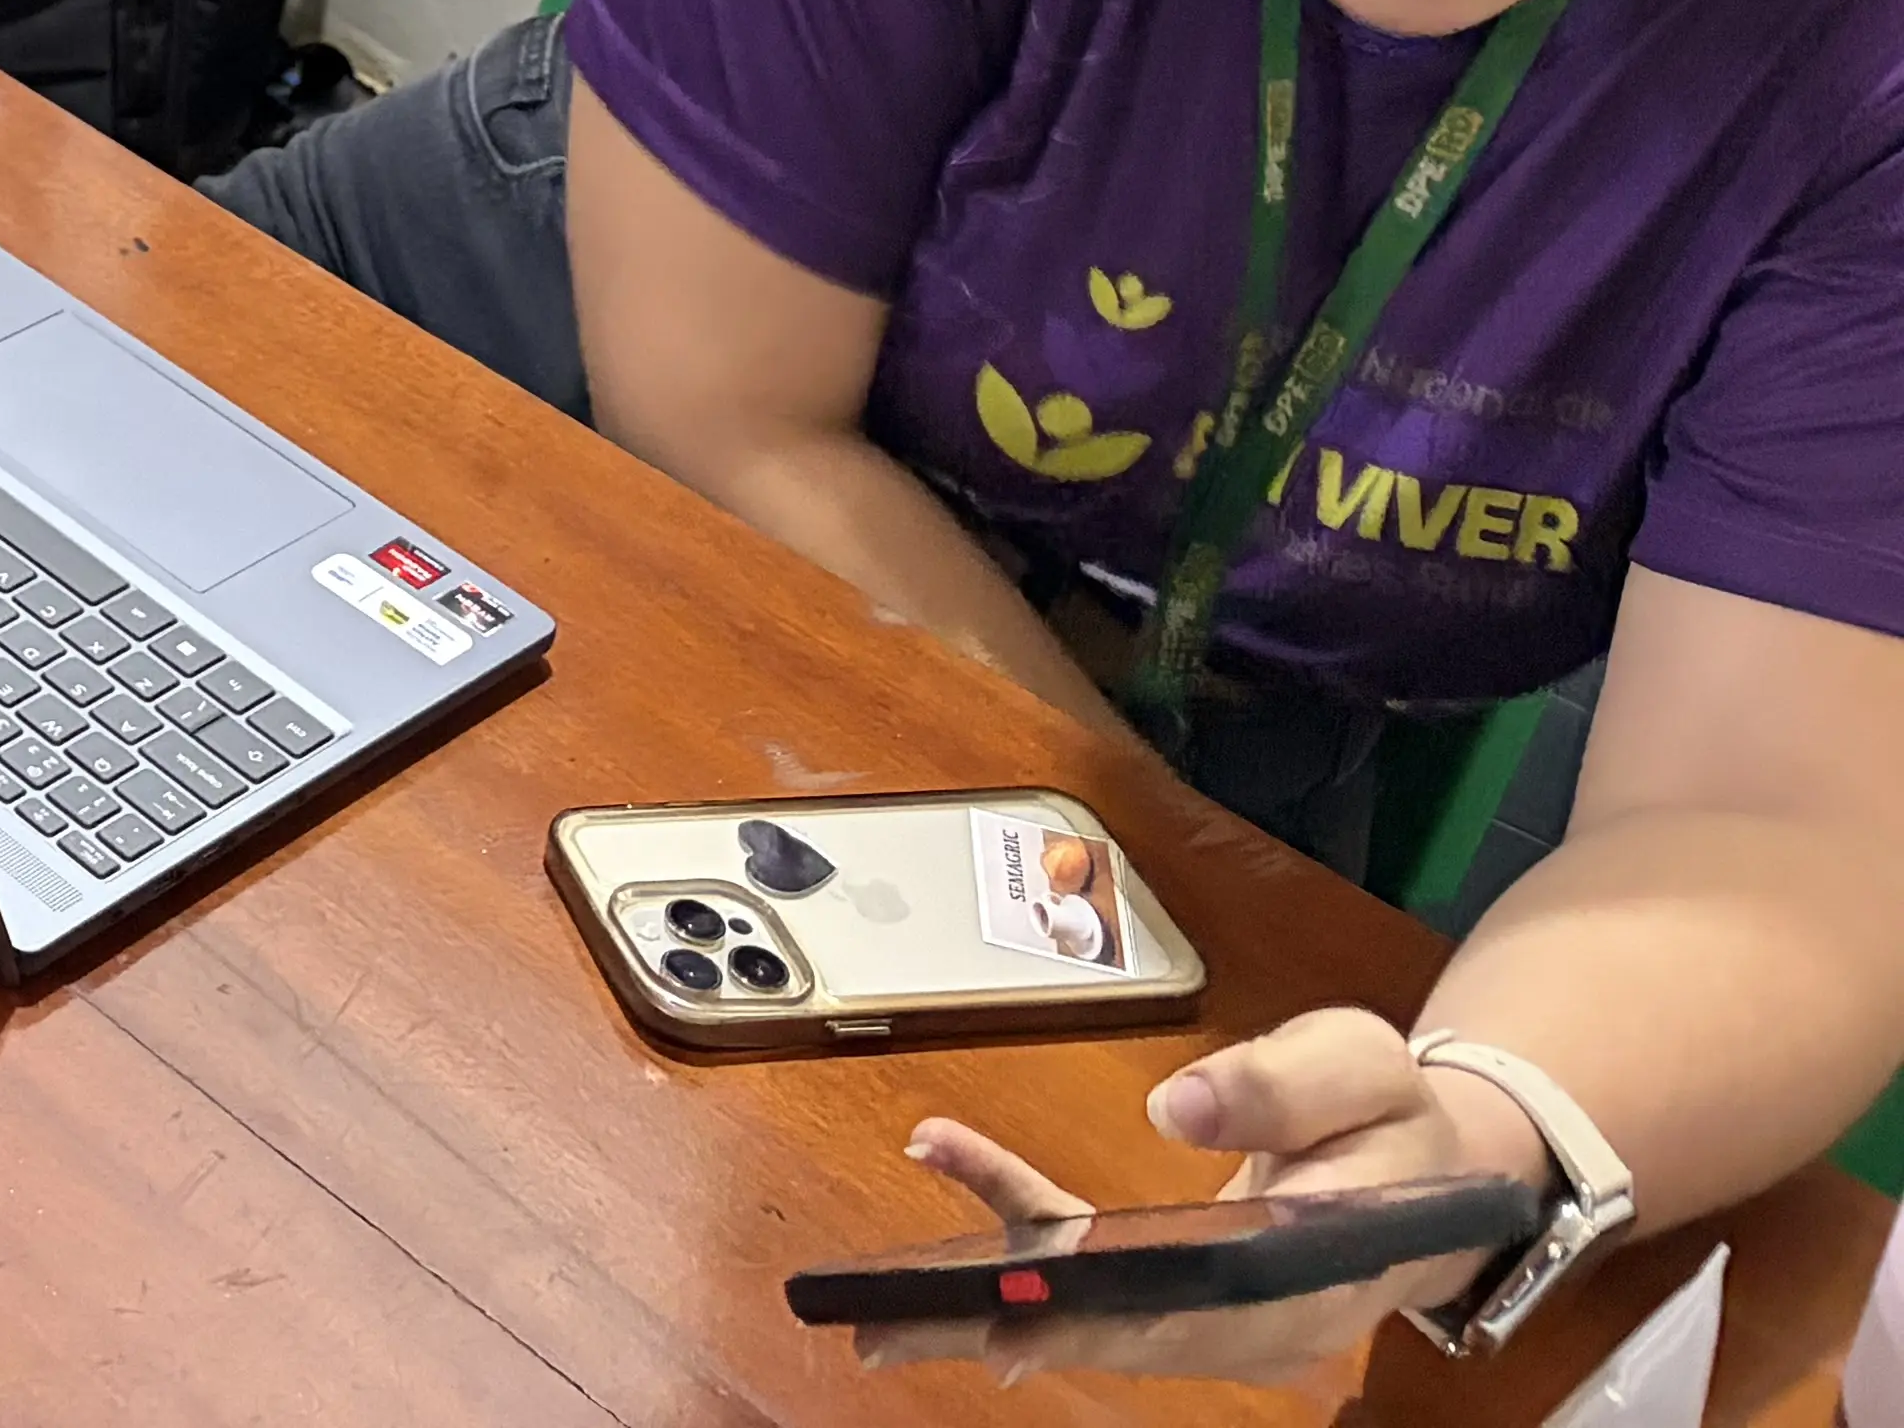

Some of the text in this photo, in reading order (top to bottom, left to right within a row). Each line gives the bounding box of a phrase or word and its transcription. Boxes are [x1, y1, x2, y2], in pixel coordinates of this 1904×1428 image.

[1395, 155, 1449, 221] DPE
[1316, 448, 1580, 573] VIVER
[1002, 828, 1027, 903] SEMAGRIC
